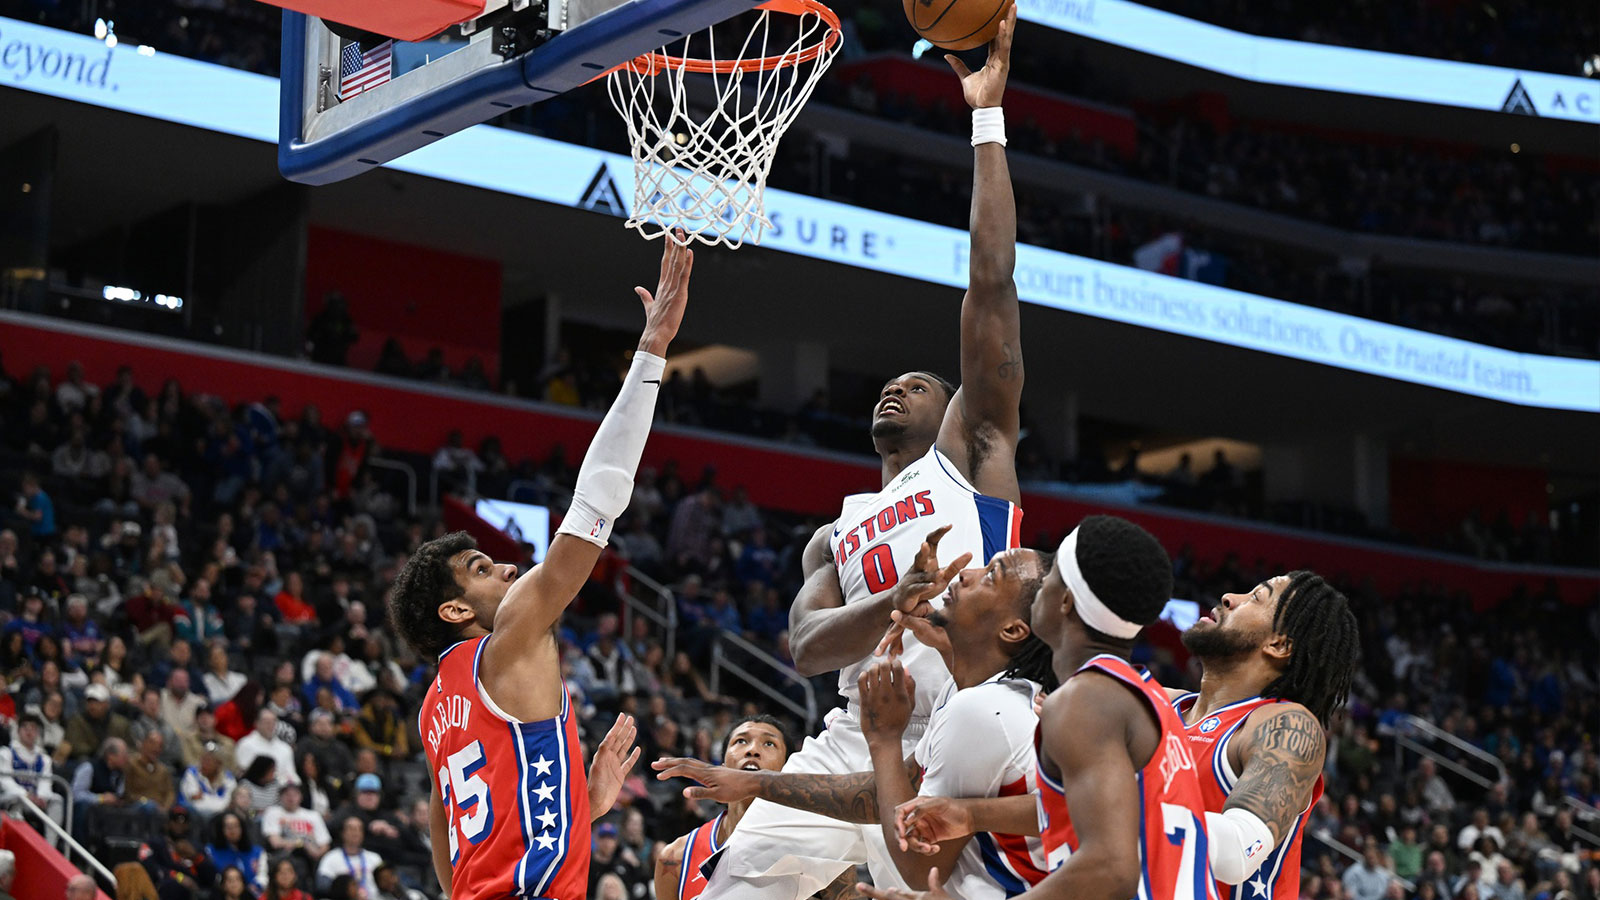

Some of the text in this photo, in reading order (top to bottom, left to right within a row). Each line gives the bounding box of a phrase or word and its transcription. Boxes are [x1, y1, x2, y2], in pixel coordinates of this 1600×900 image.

[0, 30, 119, 92] eyond.
[1091, 268, 1209, 327] business
[1339, 324, 1390, 365] One
[861, 543, 899, 595] 0
[1257, 713, 1286, 740] THE
[1262, 729, 1280, 752] IS
[438, 740, 494, 867] 25
